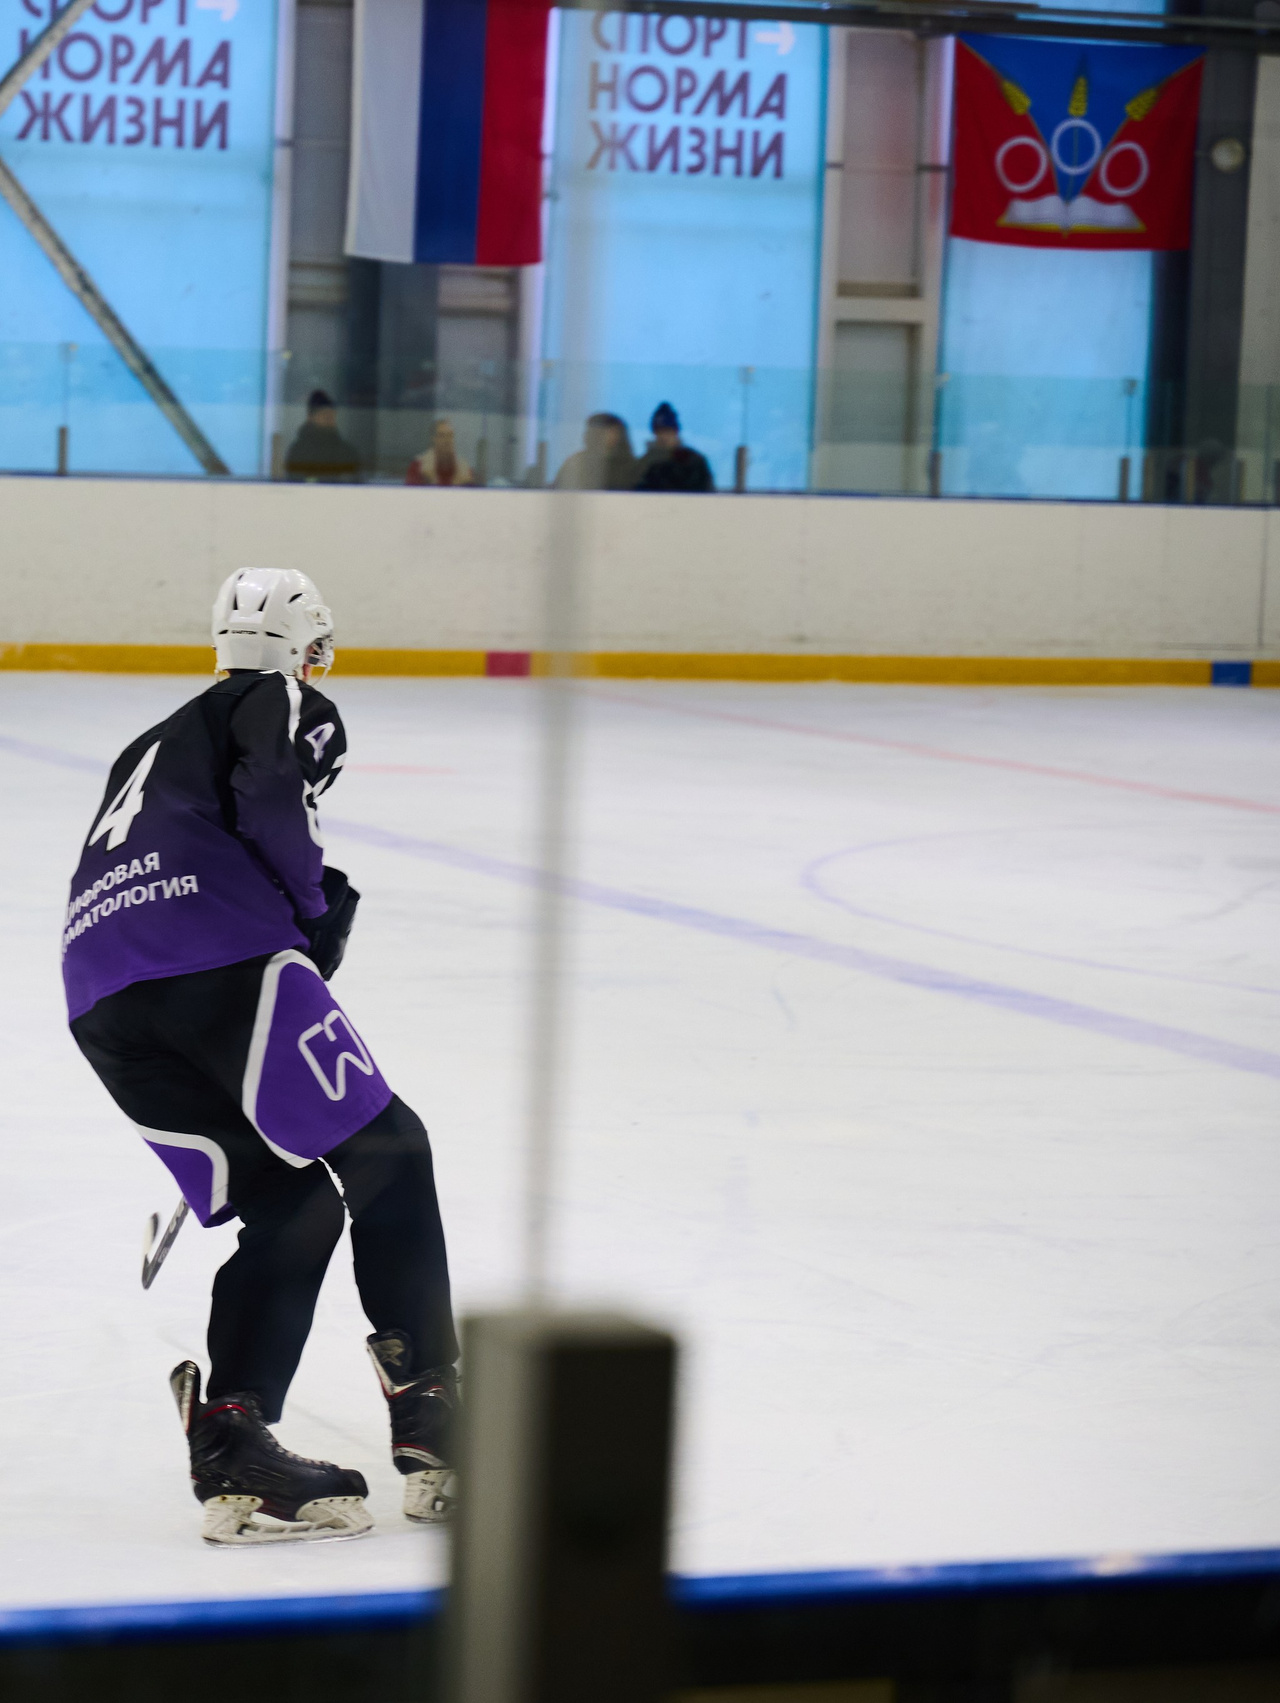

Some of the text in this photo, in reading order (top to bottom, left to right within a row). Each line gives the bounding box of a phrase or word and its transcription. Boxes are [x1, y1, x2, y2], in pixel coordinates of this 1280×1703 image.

[15, 90, 230, 150] ЖИЗНИ
[588, 60, 788, 120] НОРМА
[586, 119, 786, 179] ЖИЗНИ
[87, 740, 162, 852] 4
